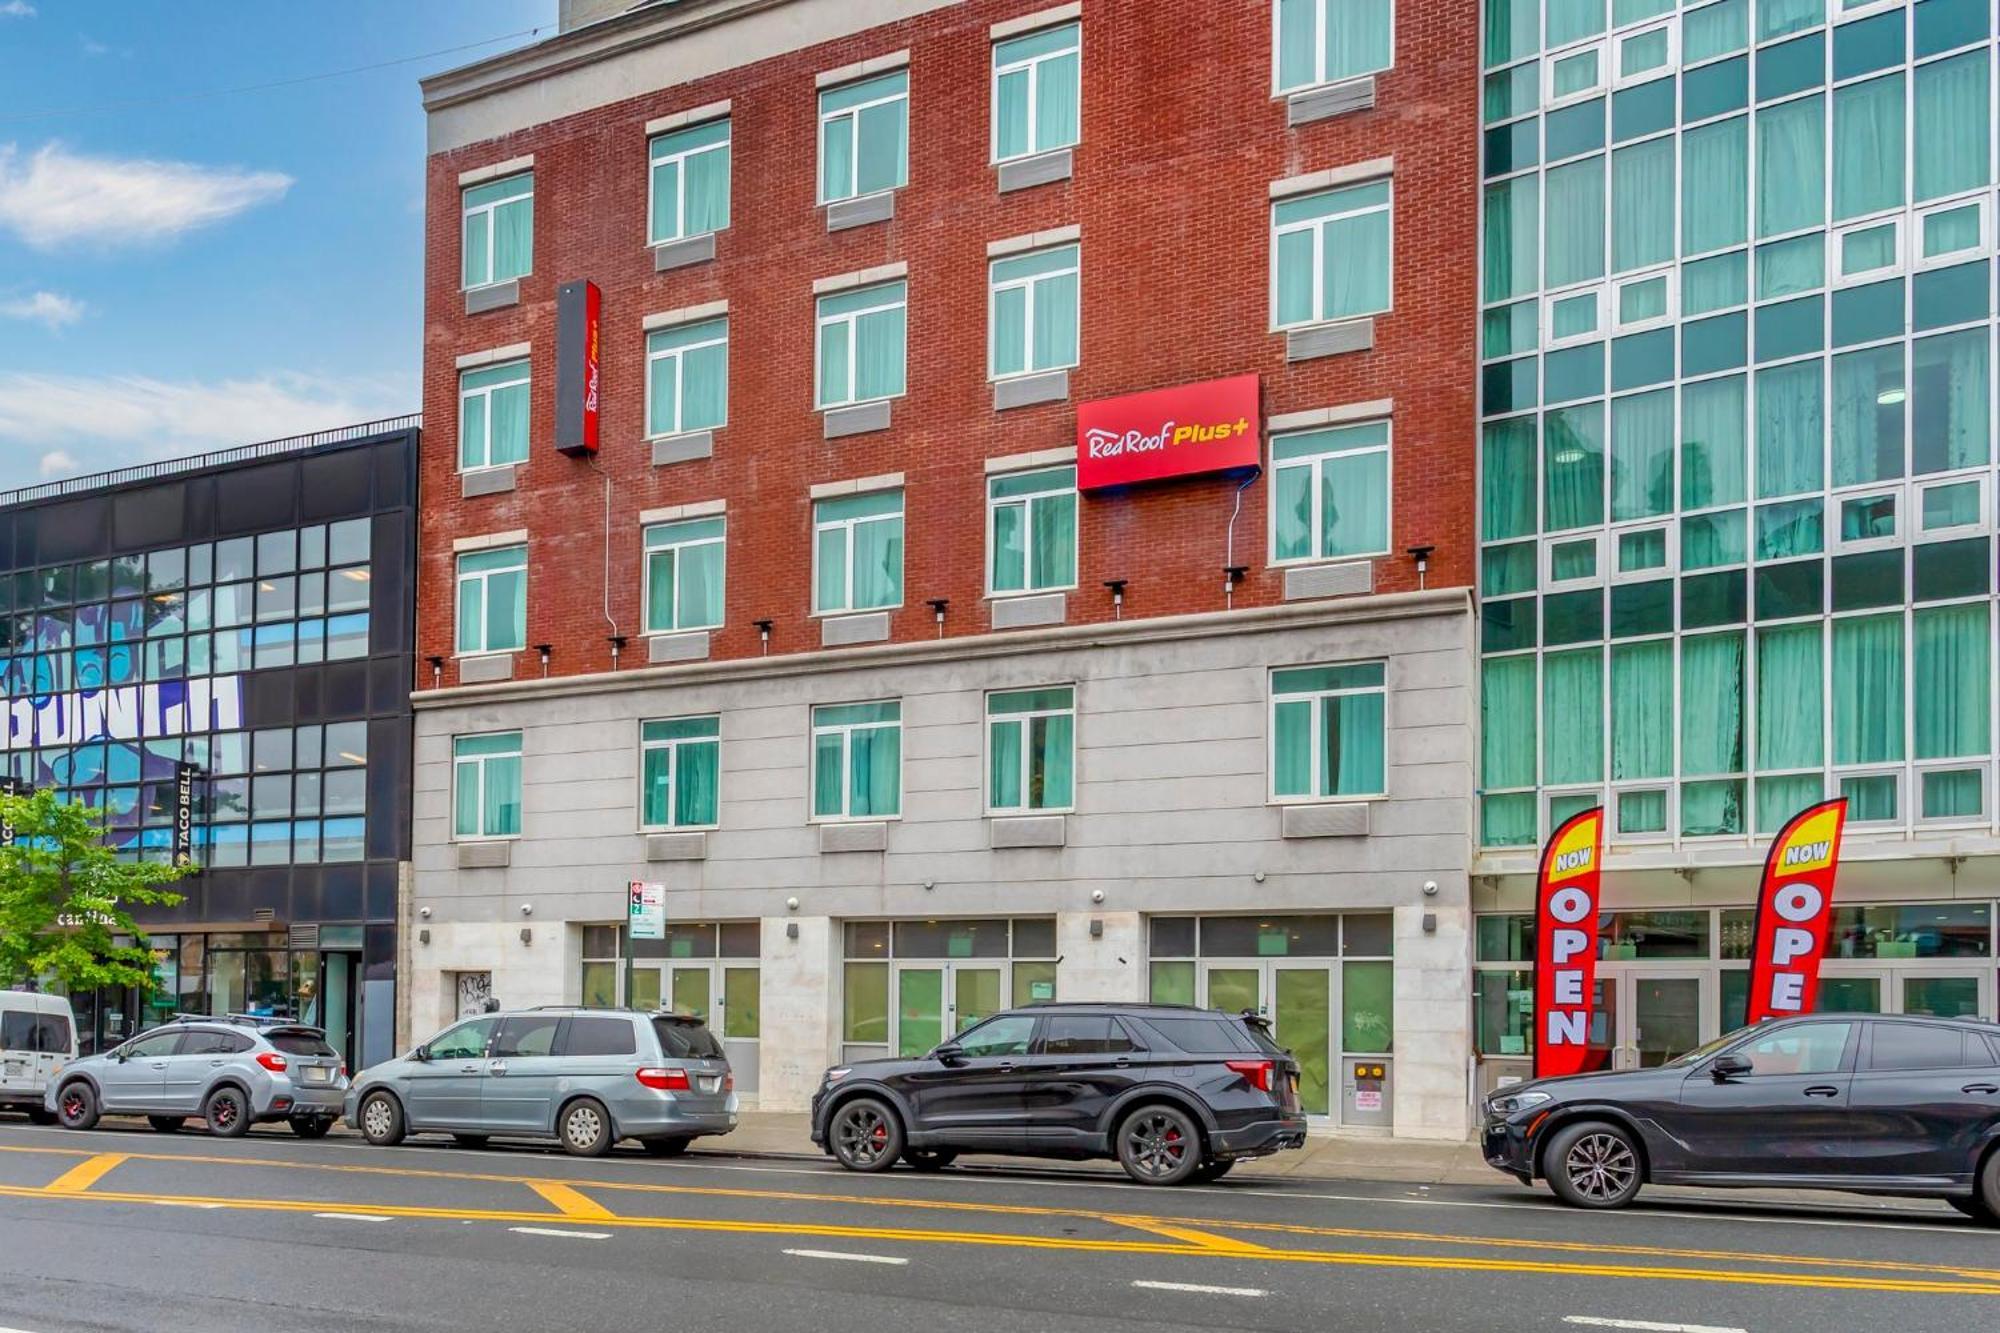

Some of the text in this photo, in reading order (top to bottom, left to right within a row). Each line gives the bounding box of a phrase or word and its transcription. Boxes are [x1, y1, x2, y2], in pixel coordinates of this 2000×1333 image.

[1173, 417, 1249, 446] Plus+
[179, 767, 191, 849] TACO BELL
[1556, 847, 1592, 873] NOW
[1784, 841, 1830, 866] NOW
[1548, 887, 1592, 1046] OPEN
